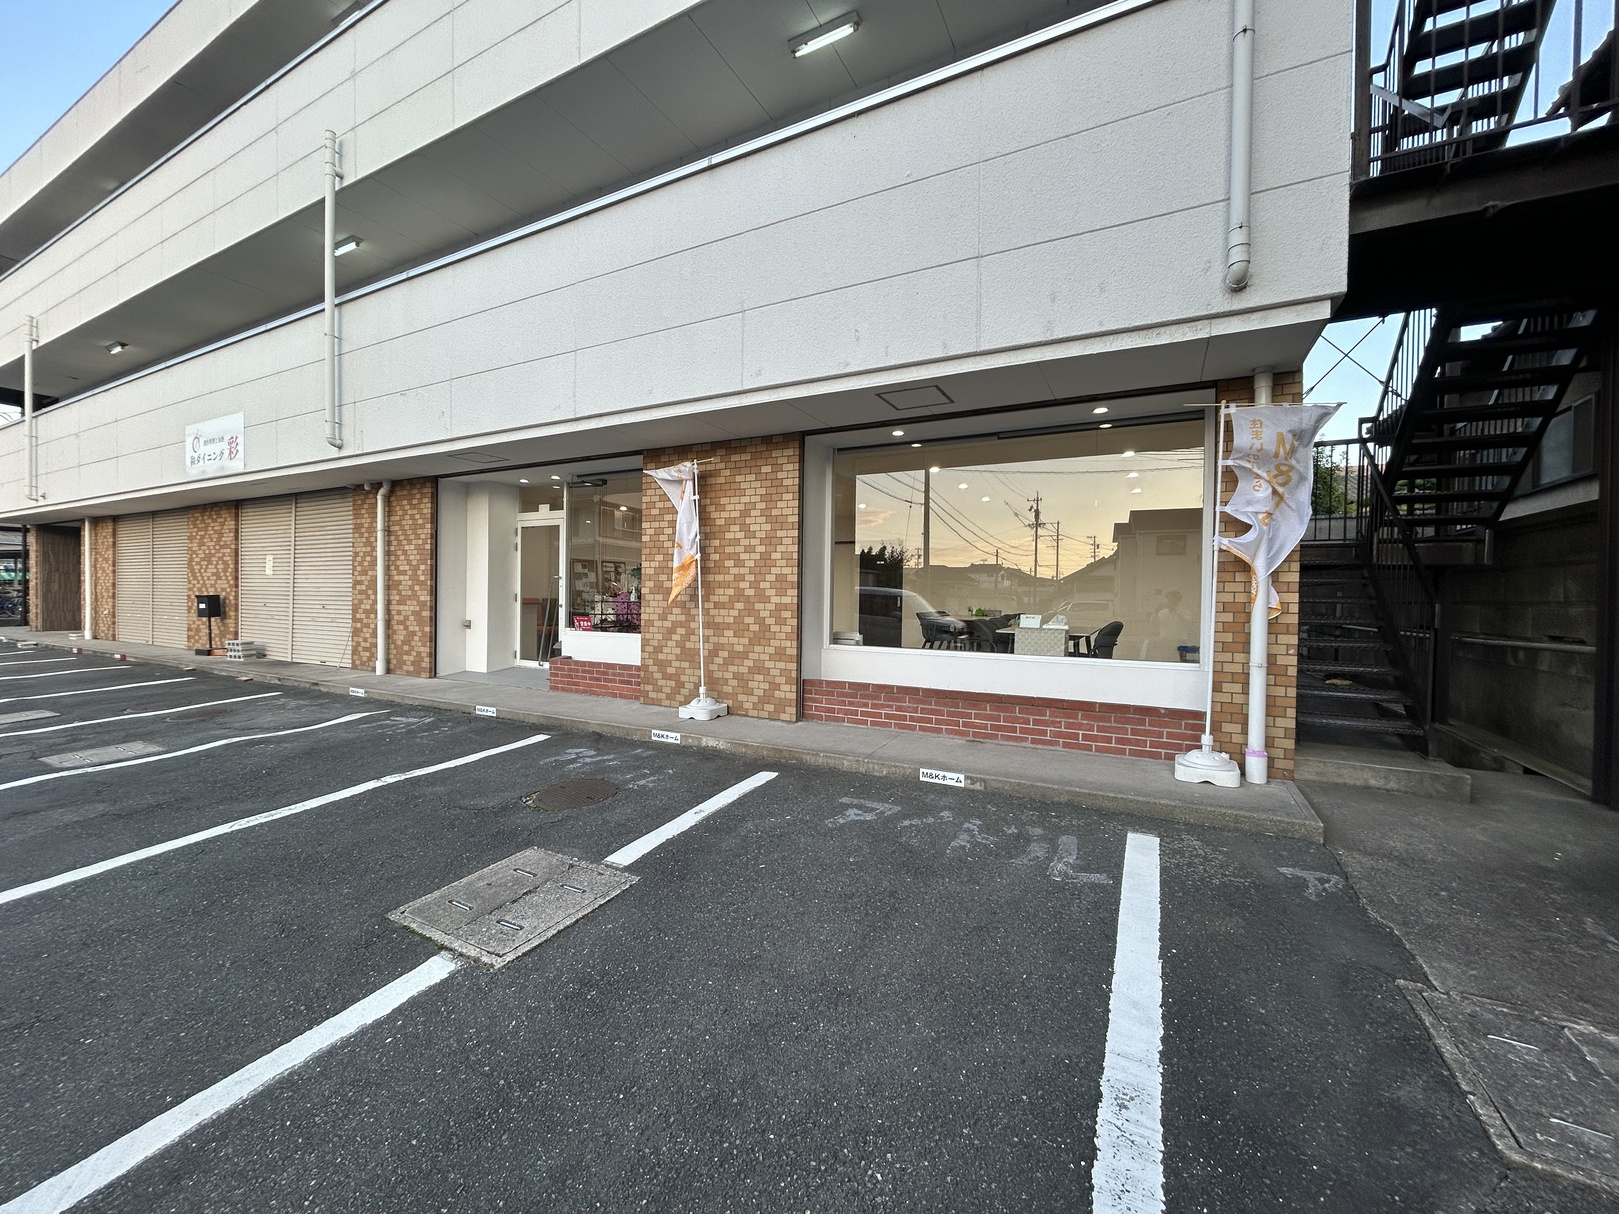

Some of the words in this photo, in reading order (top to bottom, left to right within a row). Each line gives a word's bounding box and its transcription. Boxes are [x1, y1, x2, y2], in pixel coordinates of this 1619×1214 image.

[227, 435, 239, 461] 彩
[652, 732, 679, 741] M&Kホーム
[921, 771, 963, 784] M&Kホーム
